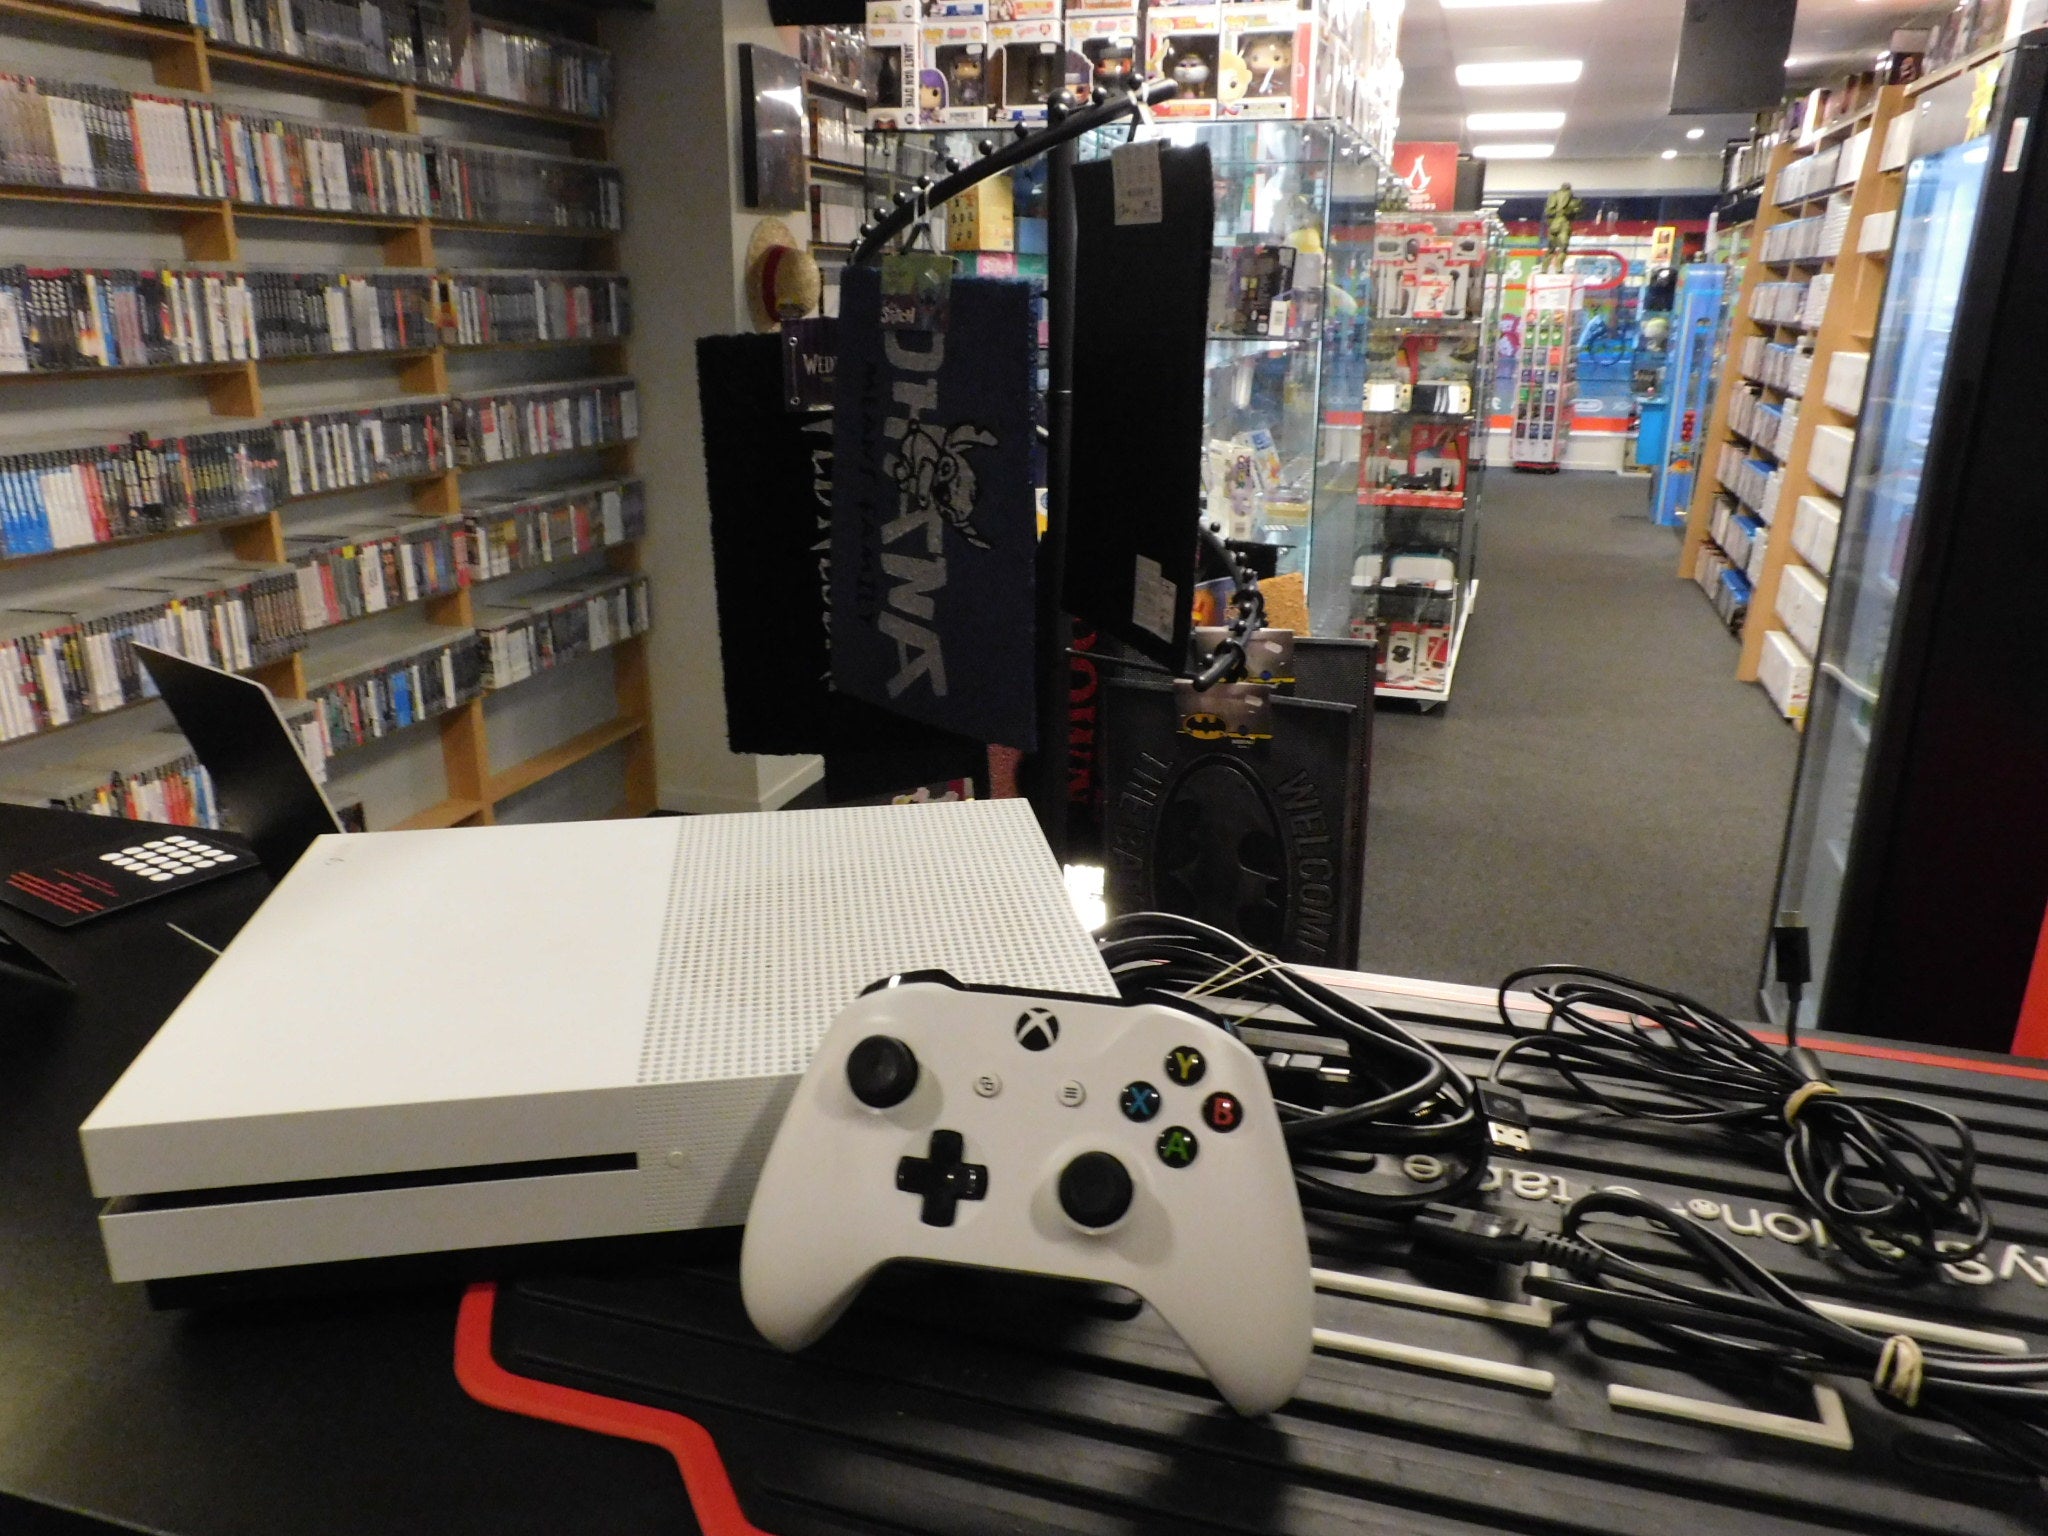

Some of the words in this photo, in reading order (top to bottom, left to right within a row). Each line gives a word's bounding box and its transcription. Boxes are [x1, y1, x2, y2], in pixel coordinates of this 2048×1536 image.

[1175, 1052, 1199, 1079] Y
[1127, 1087, 1153, 1115] X
[1213, 1097, 1234, 1126] B
[1163, 1131, 1190, 1161] A
